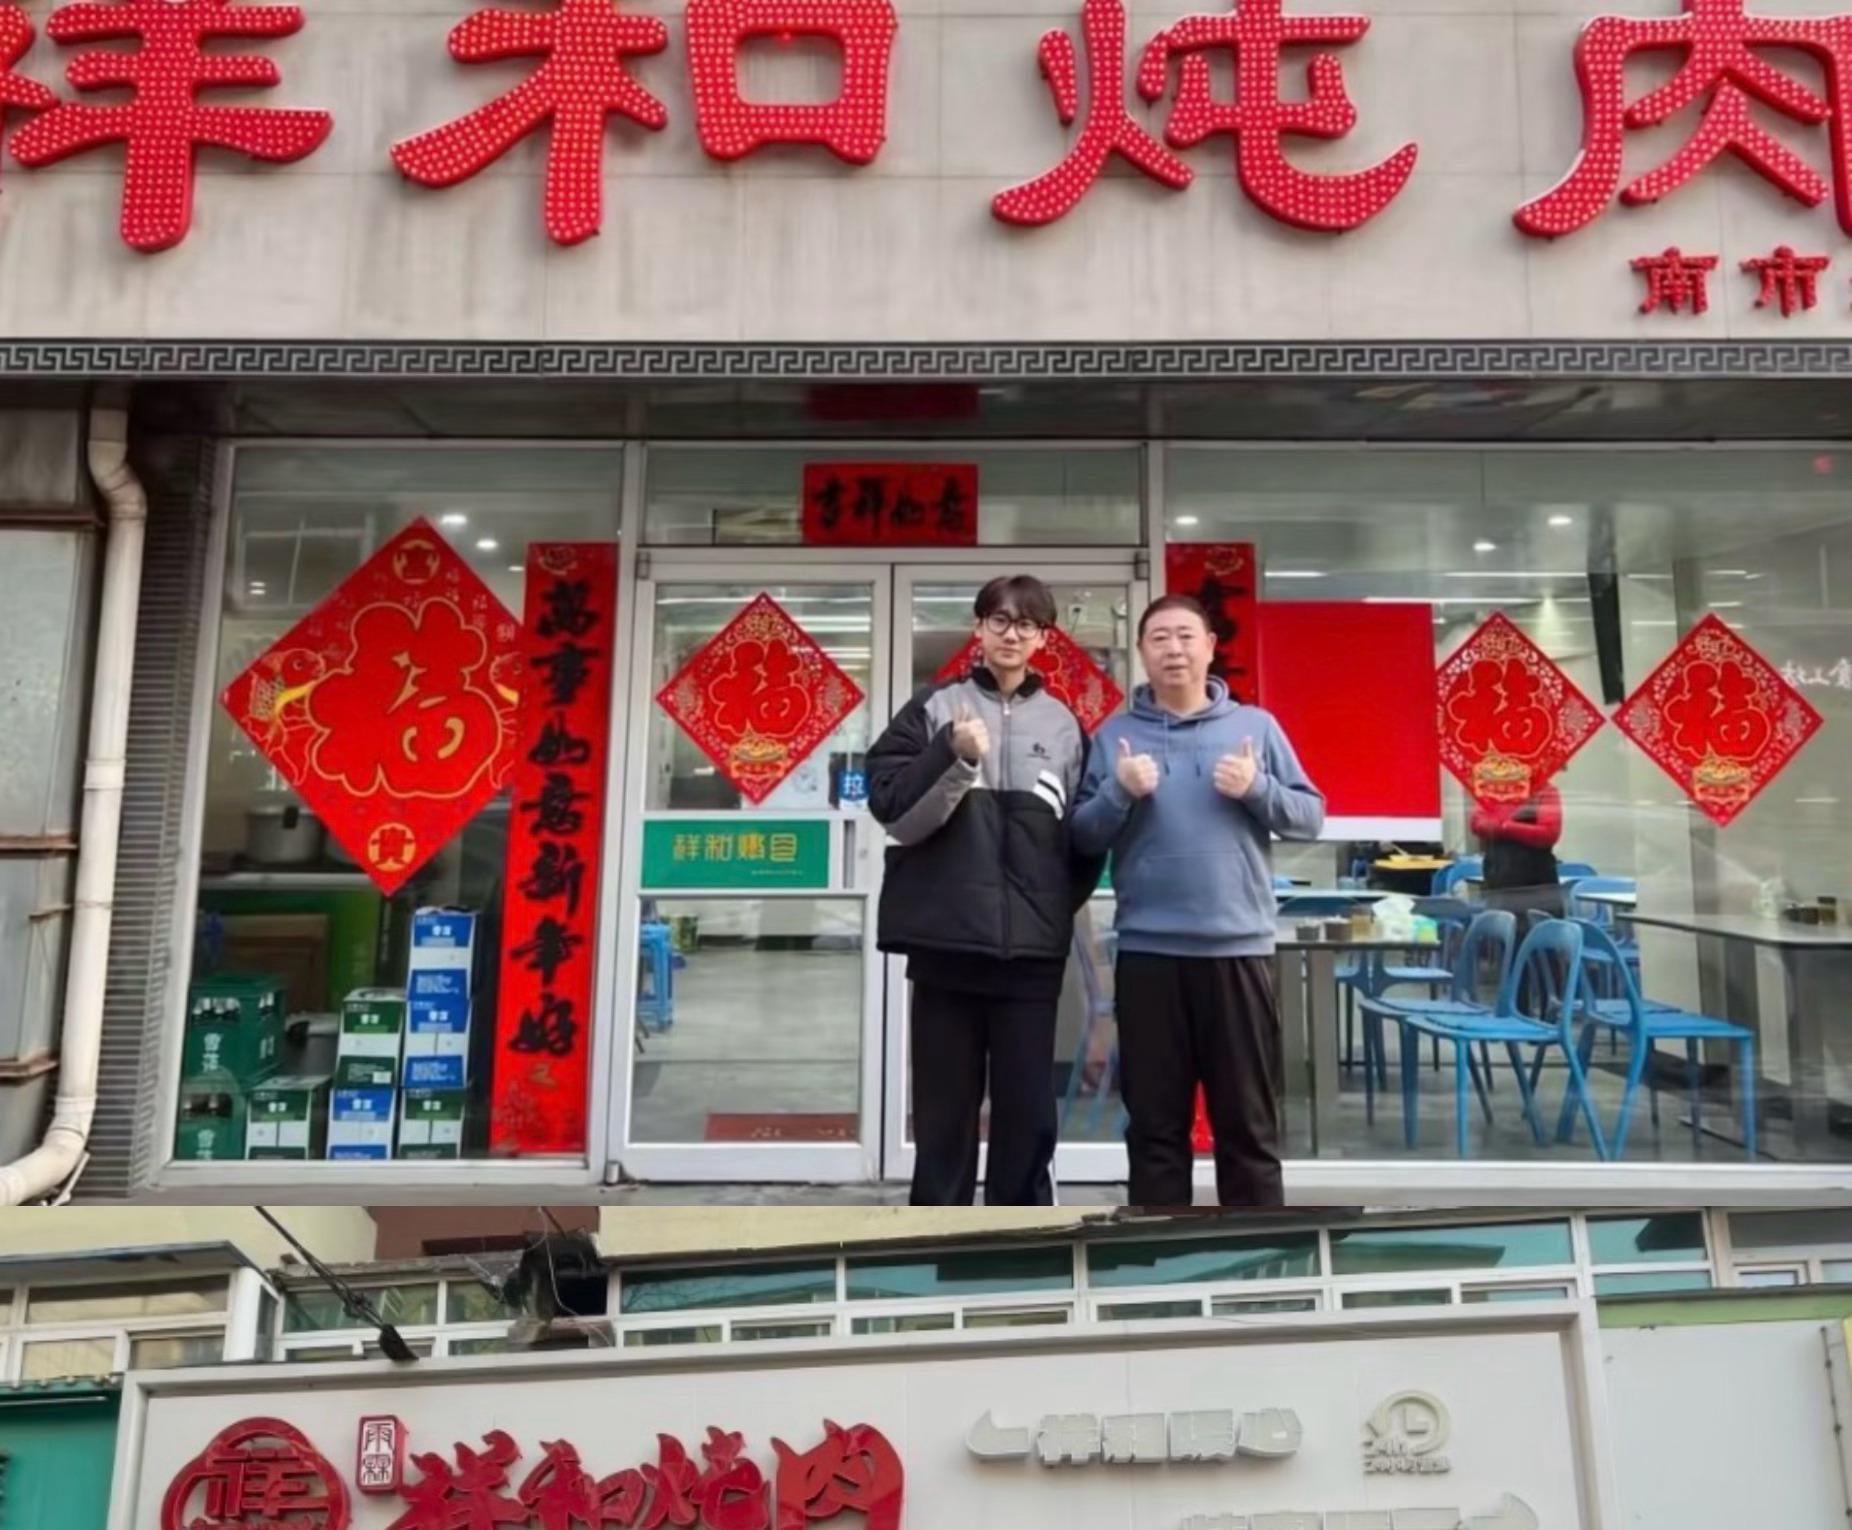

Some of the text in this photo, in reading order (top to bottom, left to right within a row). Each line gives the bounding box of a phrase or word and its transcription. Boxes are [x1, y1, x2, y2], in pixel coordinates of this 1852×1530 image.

[306, 597, 501, 799] 福
[708, 638, 811, 738] 福
[1447, 655, 1554, 758] 福
[1663, 659, 1772, 761] 福
